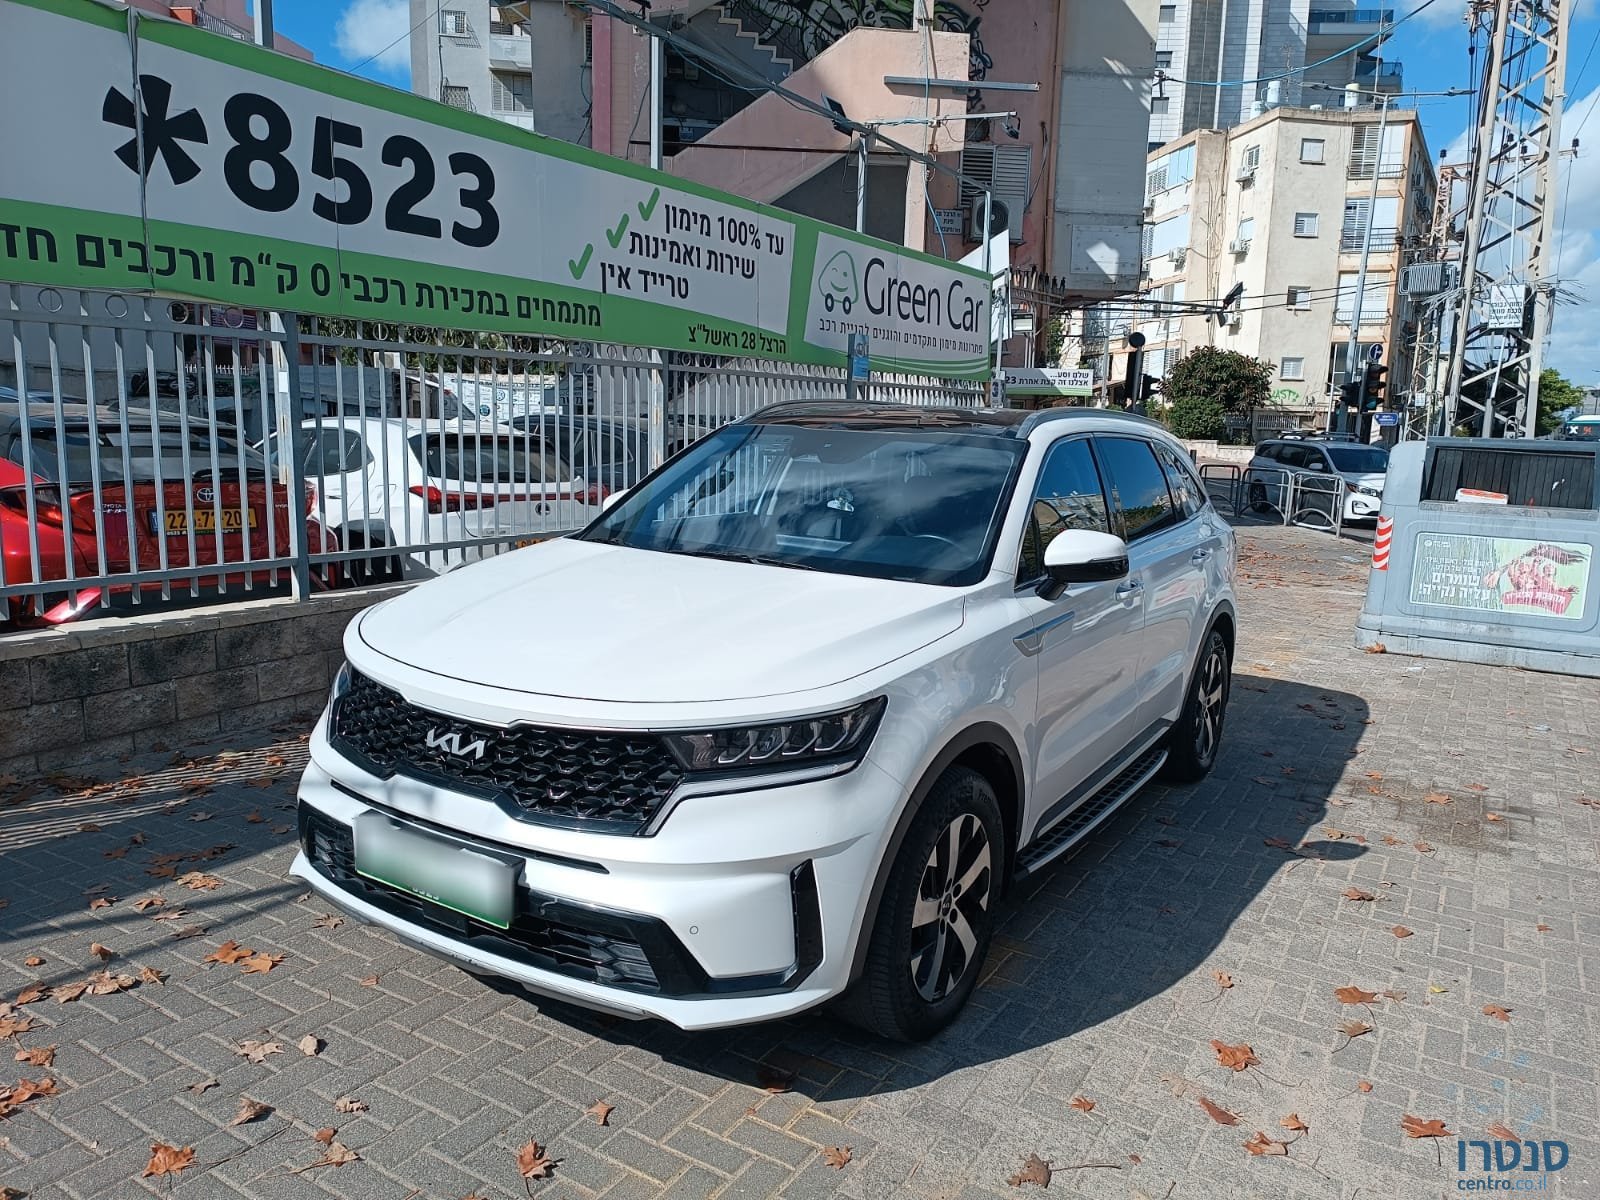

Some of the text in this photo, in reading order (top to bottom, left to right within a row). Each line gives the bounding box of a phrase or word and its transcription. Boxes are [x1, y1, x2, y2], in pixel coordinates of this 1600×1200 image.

[664, 204, 784, 256] עד 100% מימון
[76, 233, 215, 282] ורכבים
[629, 231, 755, 279] שירות ואמינות
[311, 263, 331, 297] 0
[340, 272, 407, 306] רכבי
[600, 262, 689, 299] טרייד אין
[864, 257, 984, 333] Green Car
[415, 282, 510, 317] במכירת
[516, 295, 601, 327] מתמחים
[741, 330, 756, 350] 28
[819, 318, 836, 332] רכב
[904, 332, 937, 349] מתקדמים
[759, 332, 786, 354] הרצל
[939, 337, 957, 351] מימון
[1432, 572, 1481, 586] שומרים
